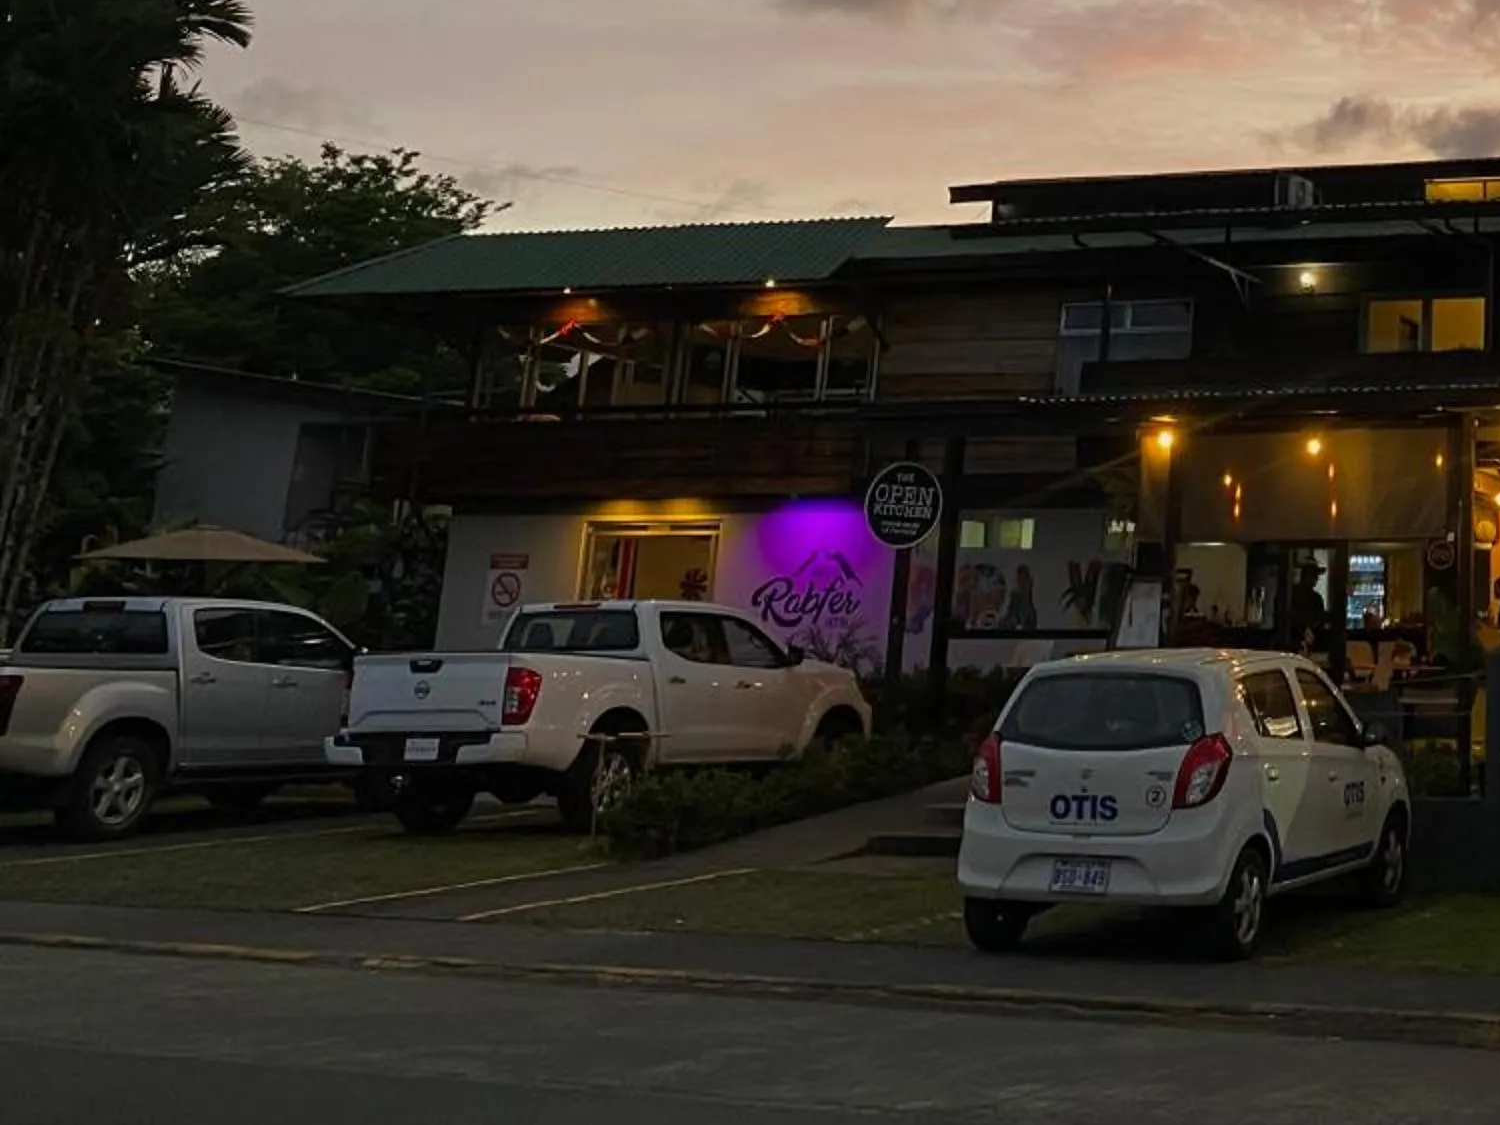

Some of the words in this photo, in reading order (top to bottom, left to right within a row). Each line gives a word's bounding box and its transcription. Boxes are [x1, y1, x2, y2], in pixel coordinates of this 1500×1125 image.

[875, 484, 935, 507] OPEN
[873, 504, 933, 520] KITCHEN
[1343, 782, 1365, 806] OTIS
[1051, 794, 1118, 820] OTIS
